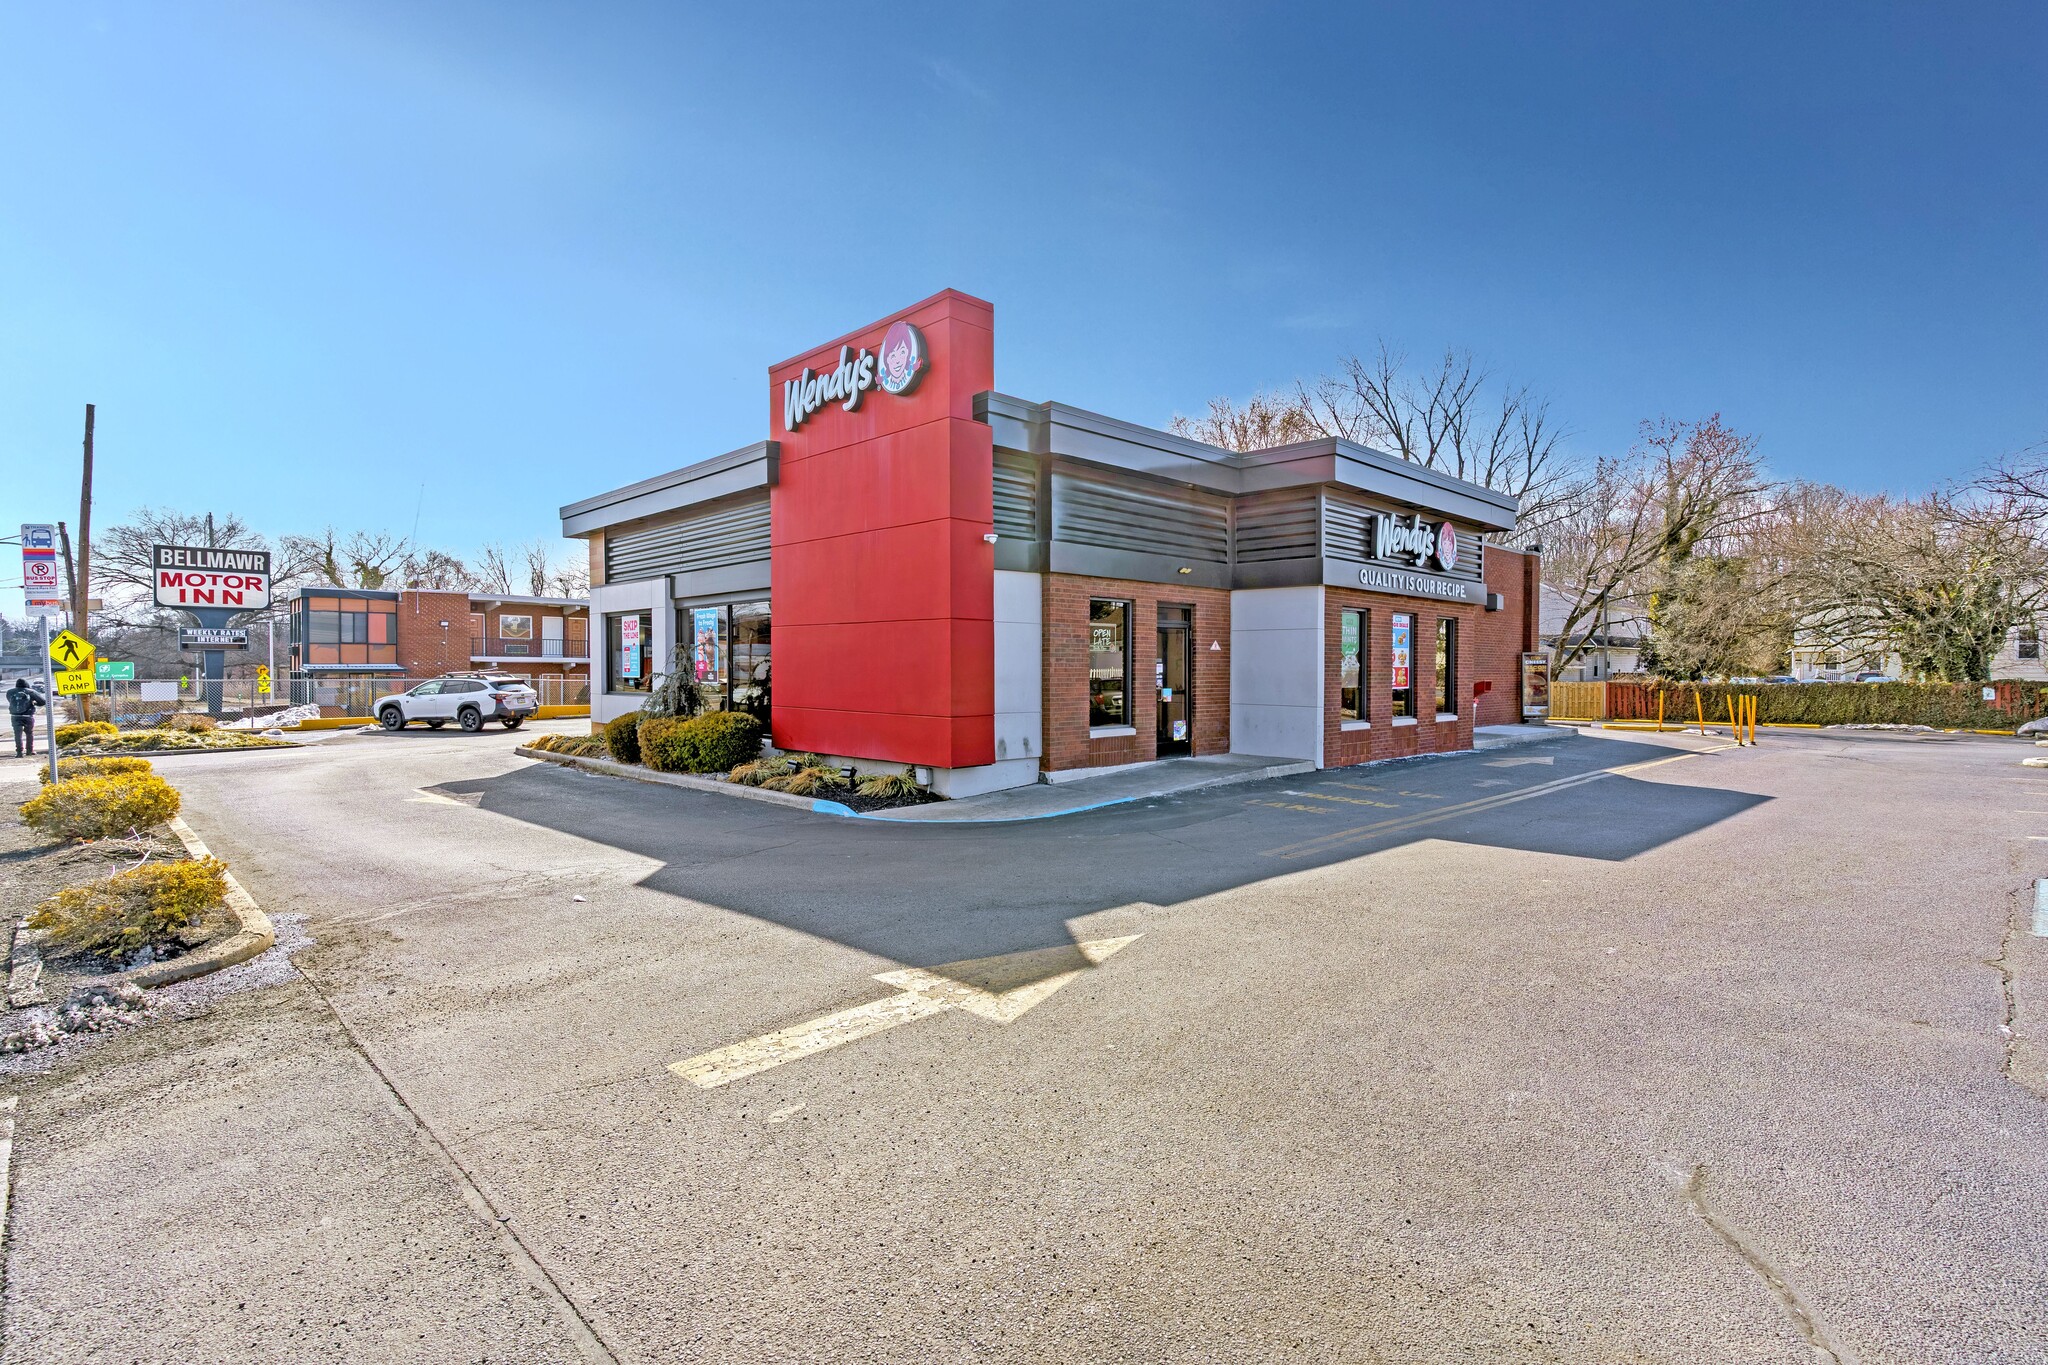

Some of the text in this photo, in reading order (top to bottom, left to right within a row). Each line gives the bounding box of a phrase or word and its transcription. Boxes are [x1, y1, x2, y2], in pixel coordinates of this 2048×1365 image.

[784, 345, 874, 431] Wendy's
[1376, 512, 1435, 567] Wendy's
[160, 548, 265, 571] BELLMAWR
[160, 571, 264, 592] MOTOR
[1359, 568, 1404, 589] QUALITY
[1405, 576, 1415, 591] IS
[1416, 578, 1436, 594] OUR
[179, 588, 243, 605] INN
[623, 620, 638, 631] SKIP
[220, 629, 246, 637] RATES
[631, 631, 639, 639] LINE
[1093, 628, 1111, 638] OPEN
[1341, 626, 1357, 636] THIN
[1093, 637, 1111, 646] LATE
[68, 674, 82, 682] ON
[62, 682, 90, 691] RAMP
